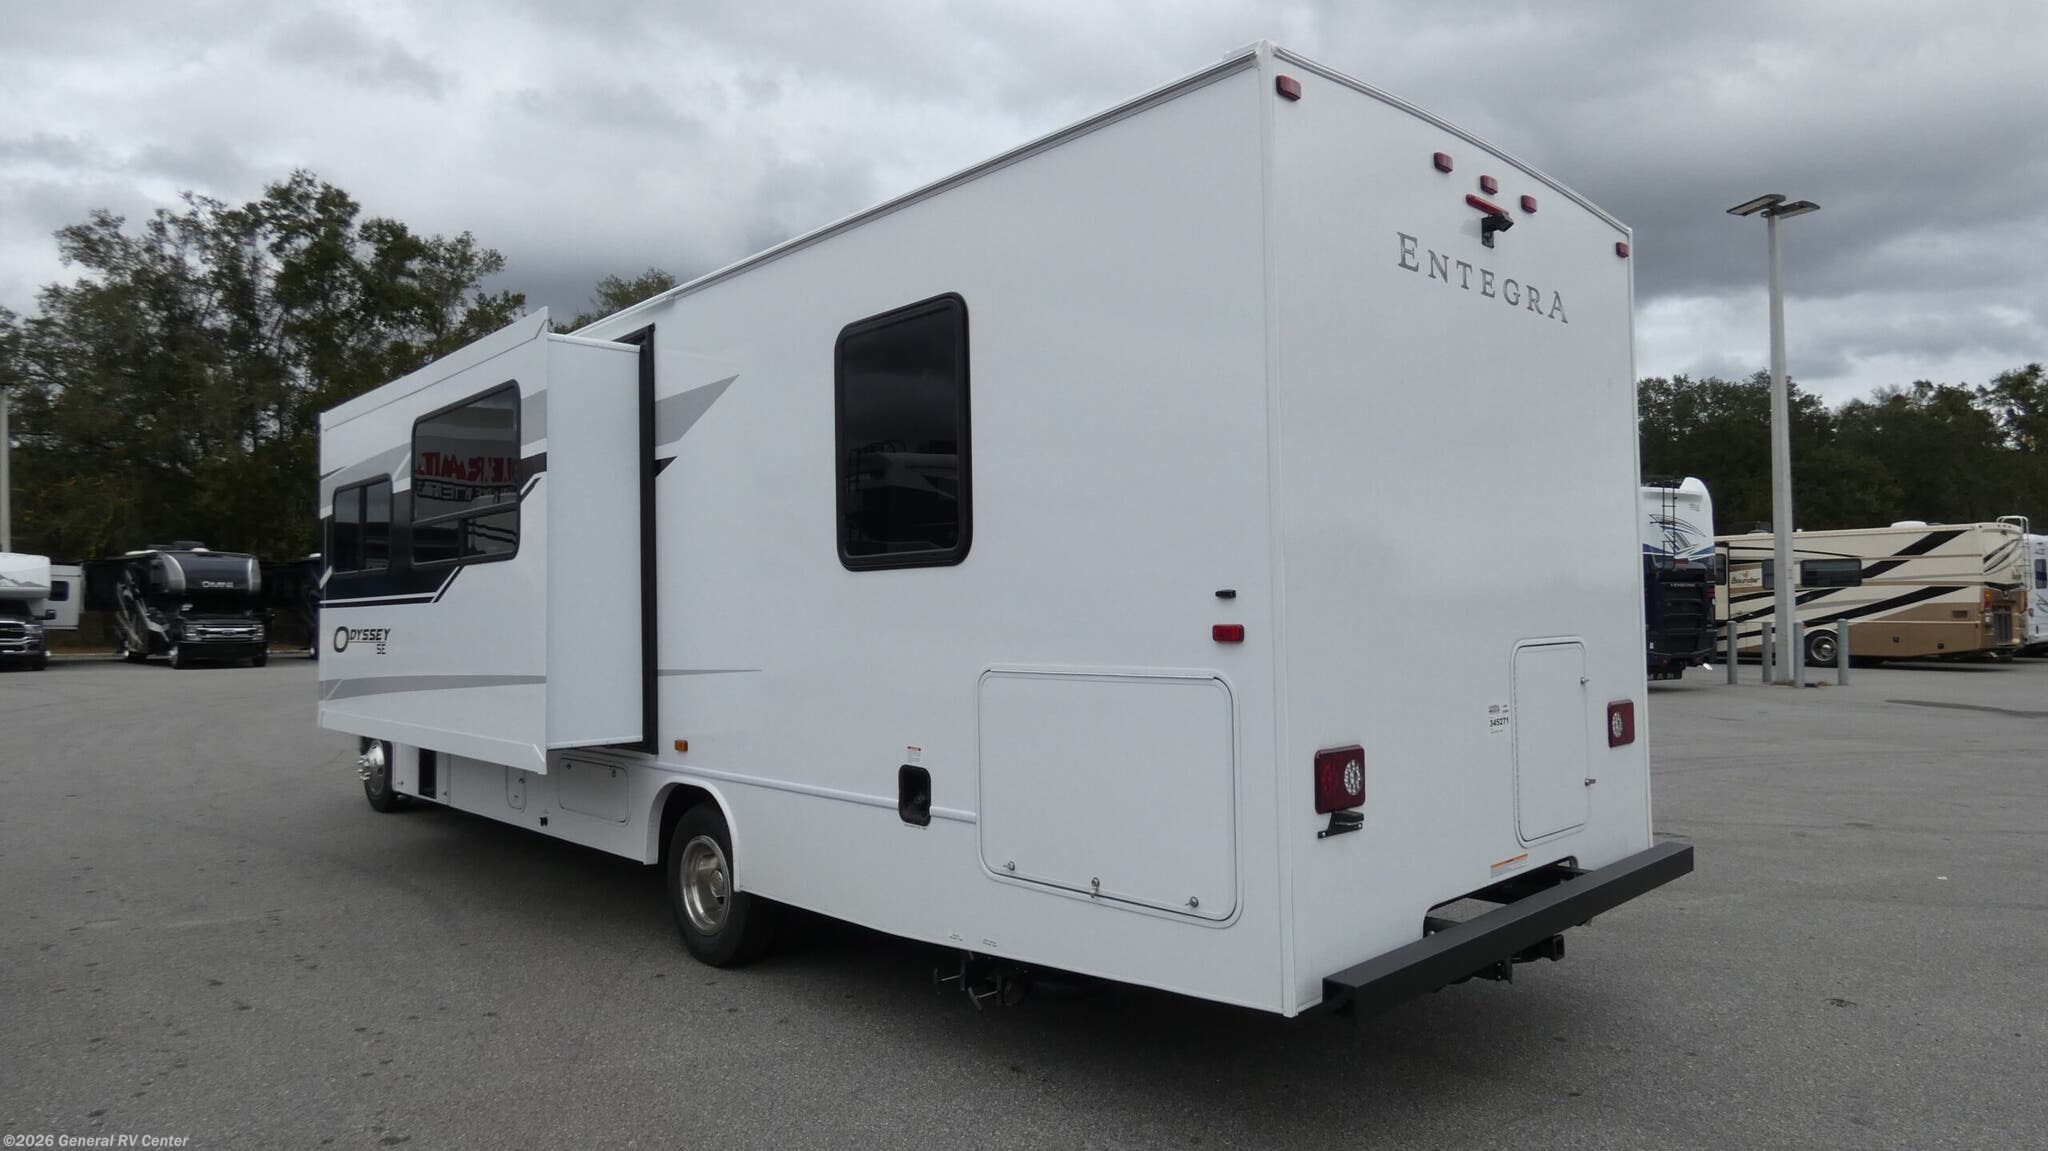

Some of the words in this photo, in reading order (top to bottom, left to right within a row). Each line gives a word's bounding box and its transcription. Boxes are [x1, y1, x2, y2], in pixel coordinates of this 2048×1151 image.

[1397, 231, 1568, 323] ENTEGRA
[334, 626, 391, 653] ODYSSEY
[376, 643, 387, 655] SE
[1489, 717, 1509, 728] 345271
